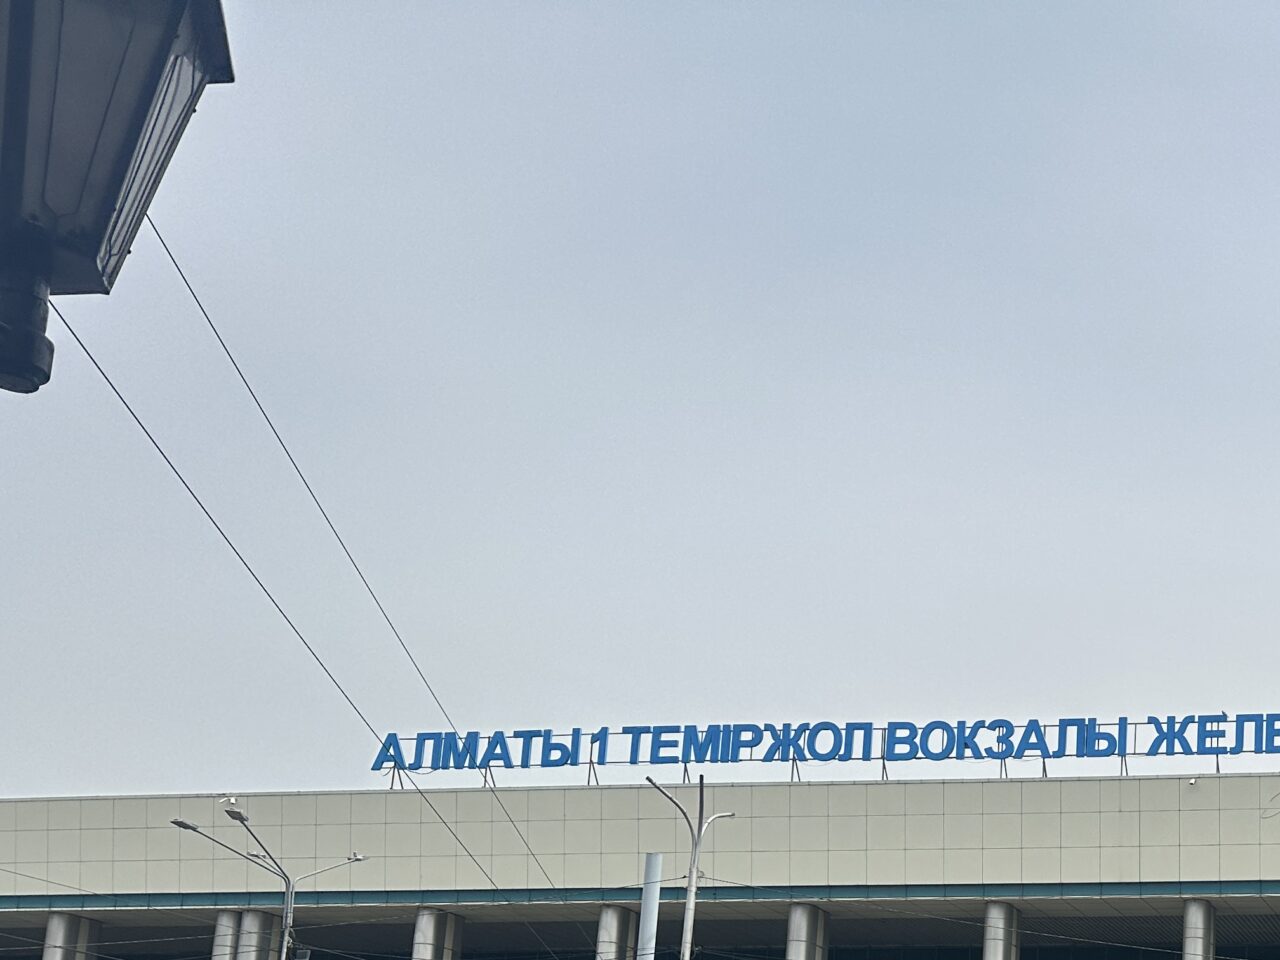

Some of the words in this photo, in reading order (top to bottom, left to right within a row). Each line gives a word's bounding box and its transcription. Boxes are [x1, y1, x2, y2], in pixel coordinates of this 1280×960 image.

[371, 728, 581, 770] АЛМАТЫ
[590, 726, 609, 766] 1
[622, 722, 873, 767] ТЕМІРЖОЛ
[885, 715, 1128, 761] ВОКЗАЛЫ
